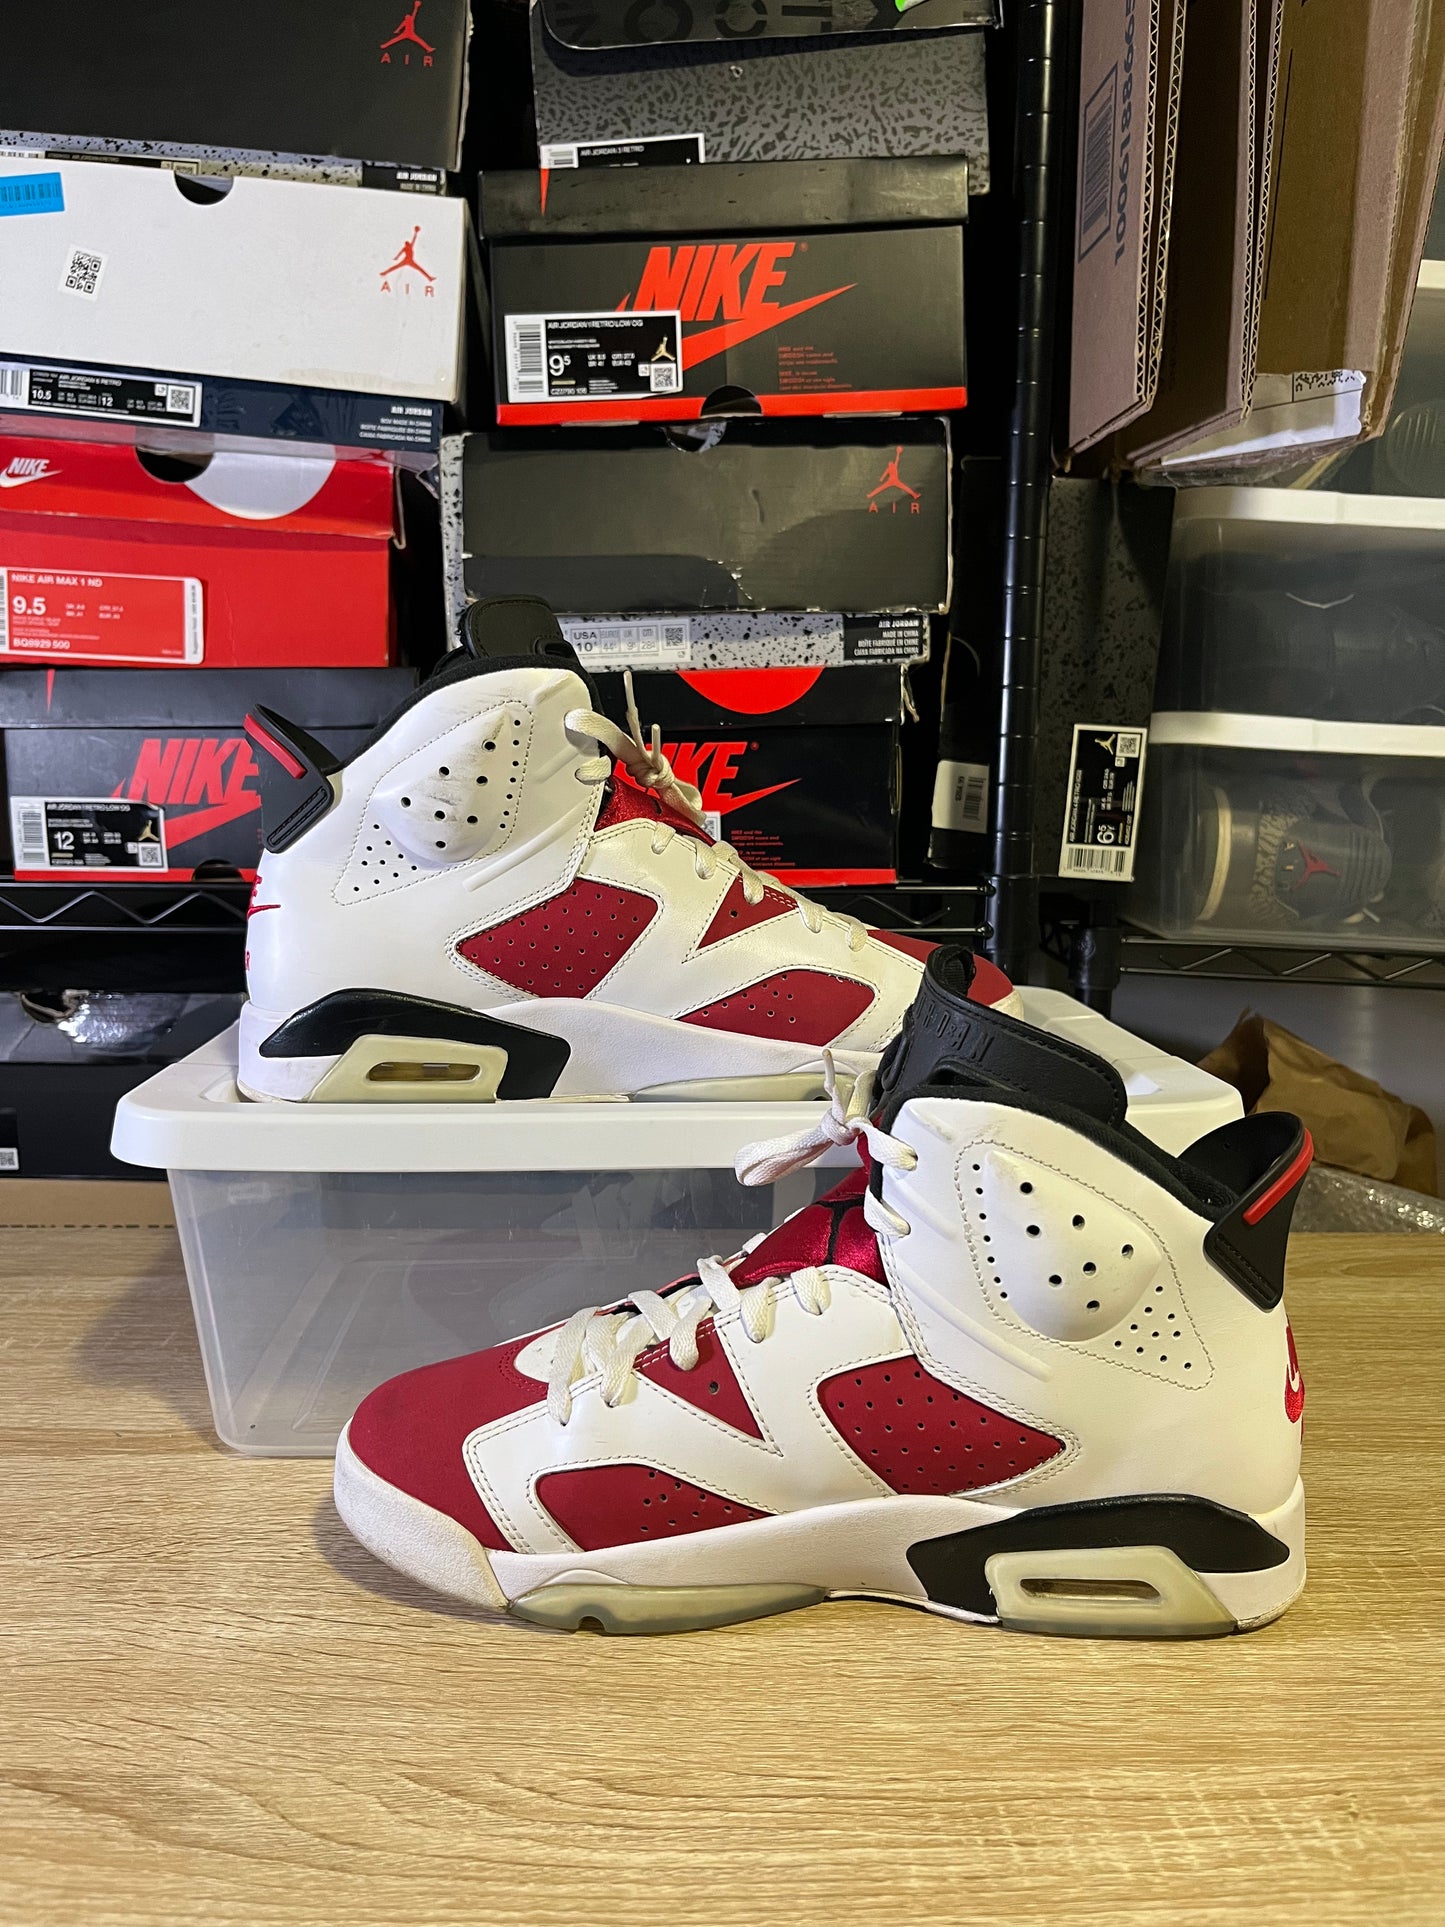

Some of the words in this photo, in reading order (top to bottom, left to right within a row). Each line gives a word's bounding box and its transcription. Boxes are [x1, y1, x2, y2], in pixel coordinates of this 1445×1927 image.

[380, 52, 433, 67] AIR
[380, 280, 435, 298] AIR
[632, 242, 796, 322] NIKE
[102, 397, 113, 407] 12
[8, 457, 50, 475] NIKE
[868, 501, 920, 514] AIR
[11, 573, 36, 584] NIKE
[37, 575, 55, 584] AIR
[55, 576, 78, 586] MAX
[87, 578, 103, 588] ND
[12, 596, 46, 616] 9.5
[892, 620, 919, 628] JORDAN
[573, 631, 597, 640] USA
[54, 831, 75, 850] 12
